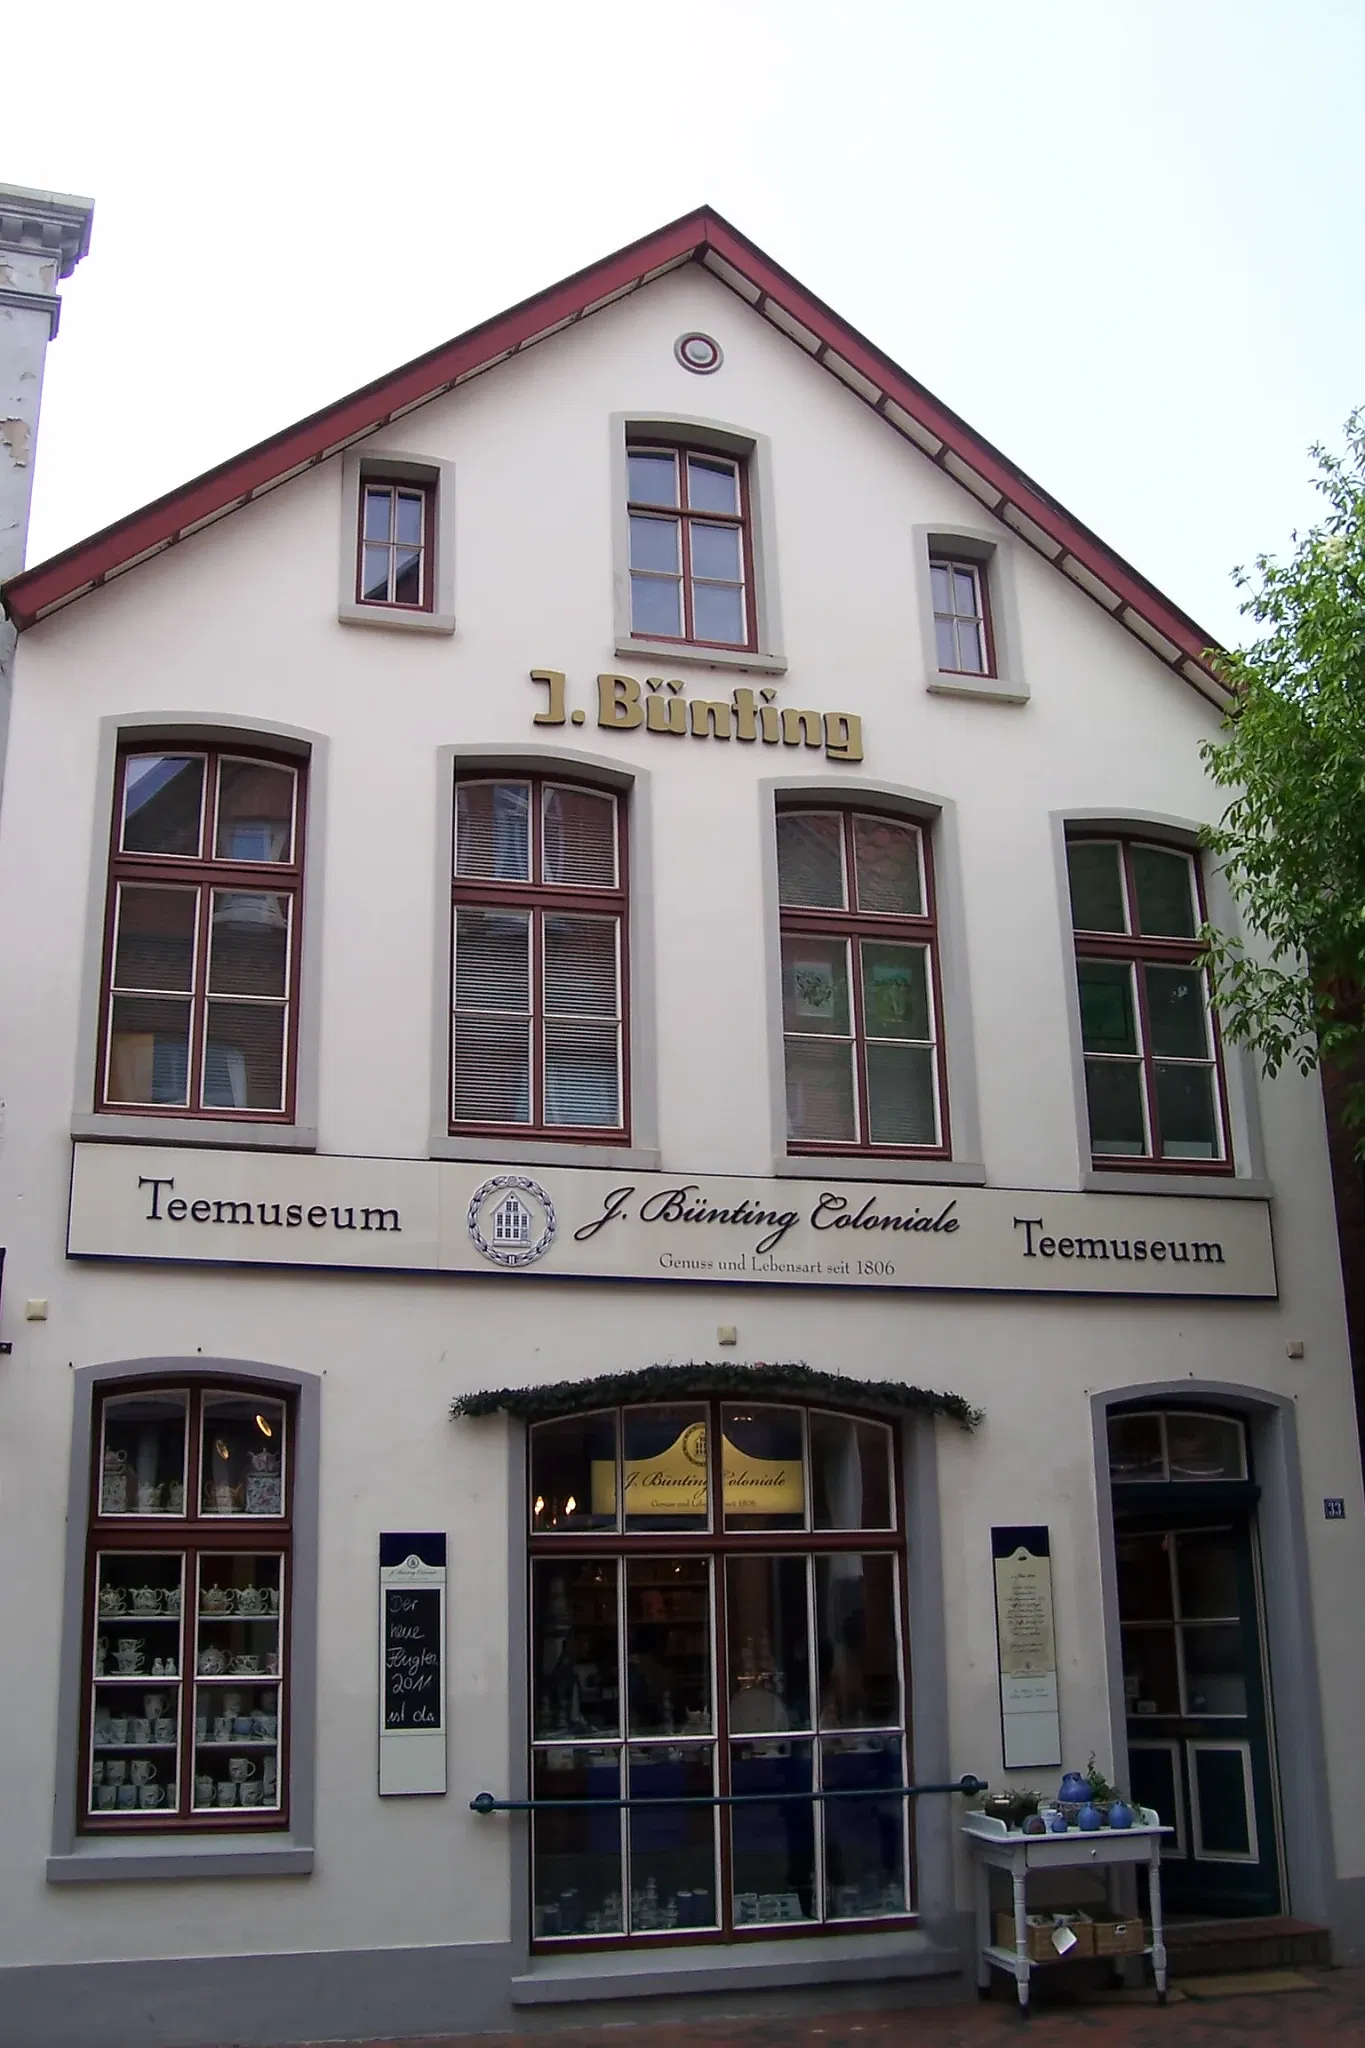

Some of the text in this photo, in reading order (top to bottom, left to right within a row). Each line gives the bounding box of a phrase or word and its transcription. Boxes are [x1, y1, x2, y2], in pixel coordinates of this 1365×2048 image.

[597, 673, 864, 762] Bünting
[138, 1175, 402, 1232] Teemuseum
[574, 1185, 960, 1254] J. Bünting Coloniale
[1013, 1216, 1226, 1264] Teemuseum
[659, 1253, 895, 1276] Genuss und Lebensart seit 1806
[390, 1595, 419, 1613] Der
[413, 1705, 435, 1722] da
